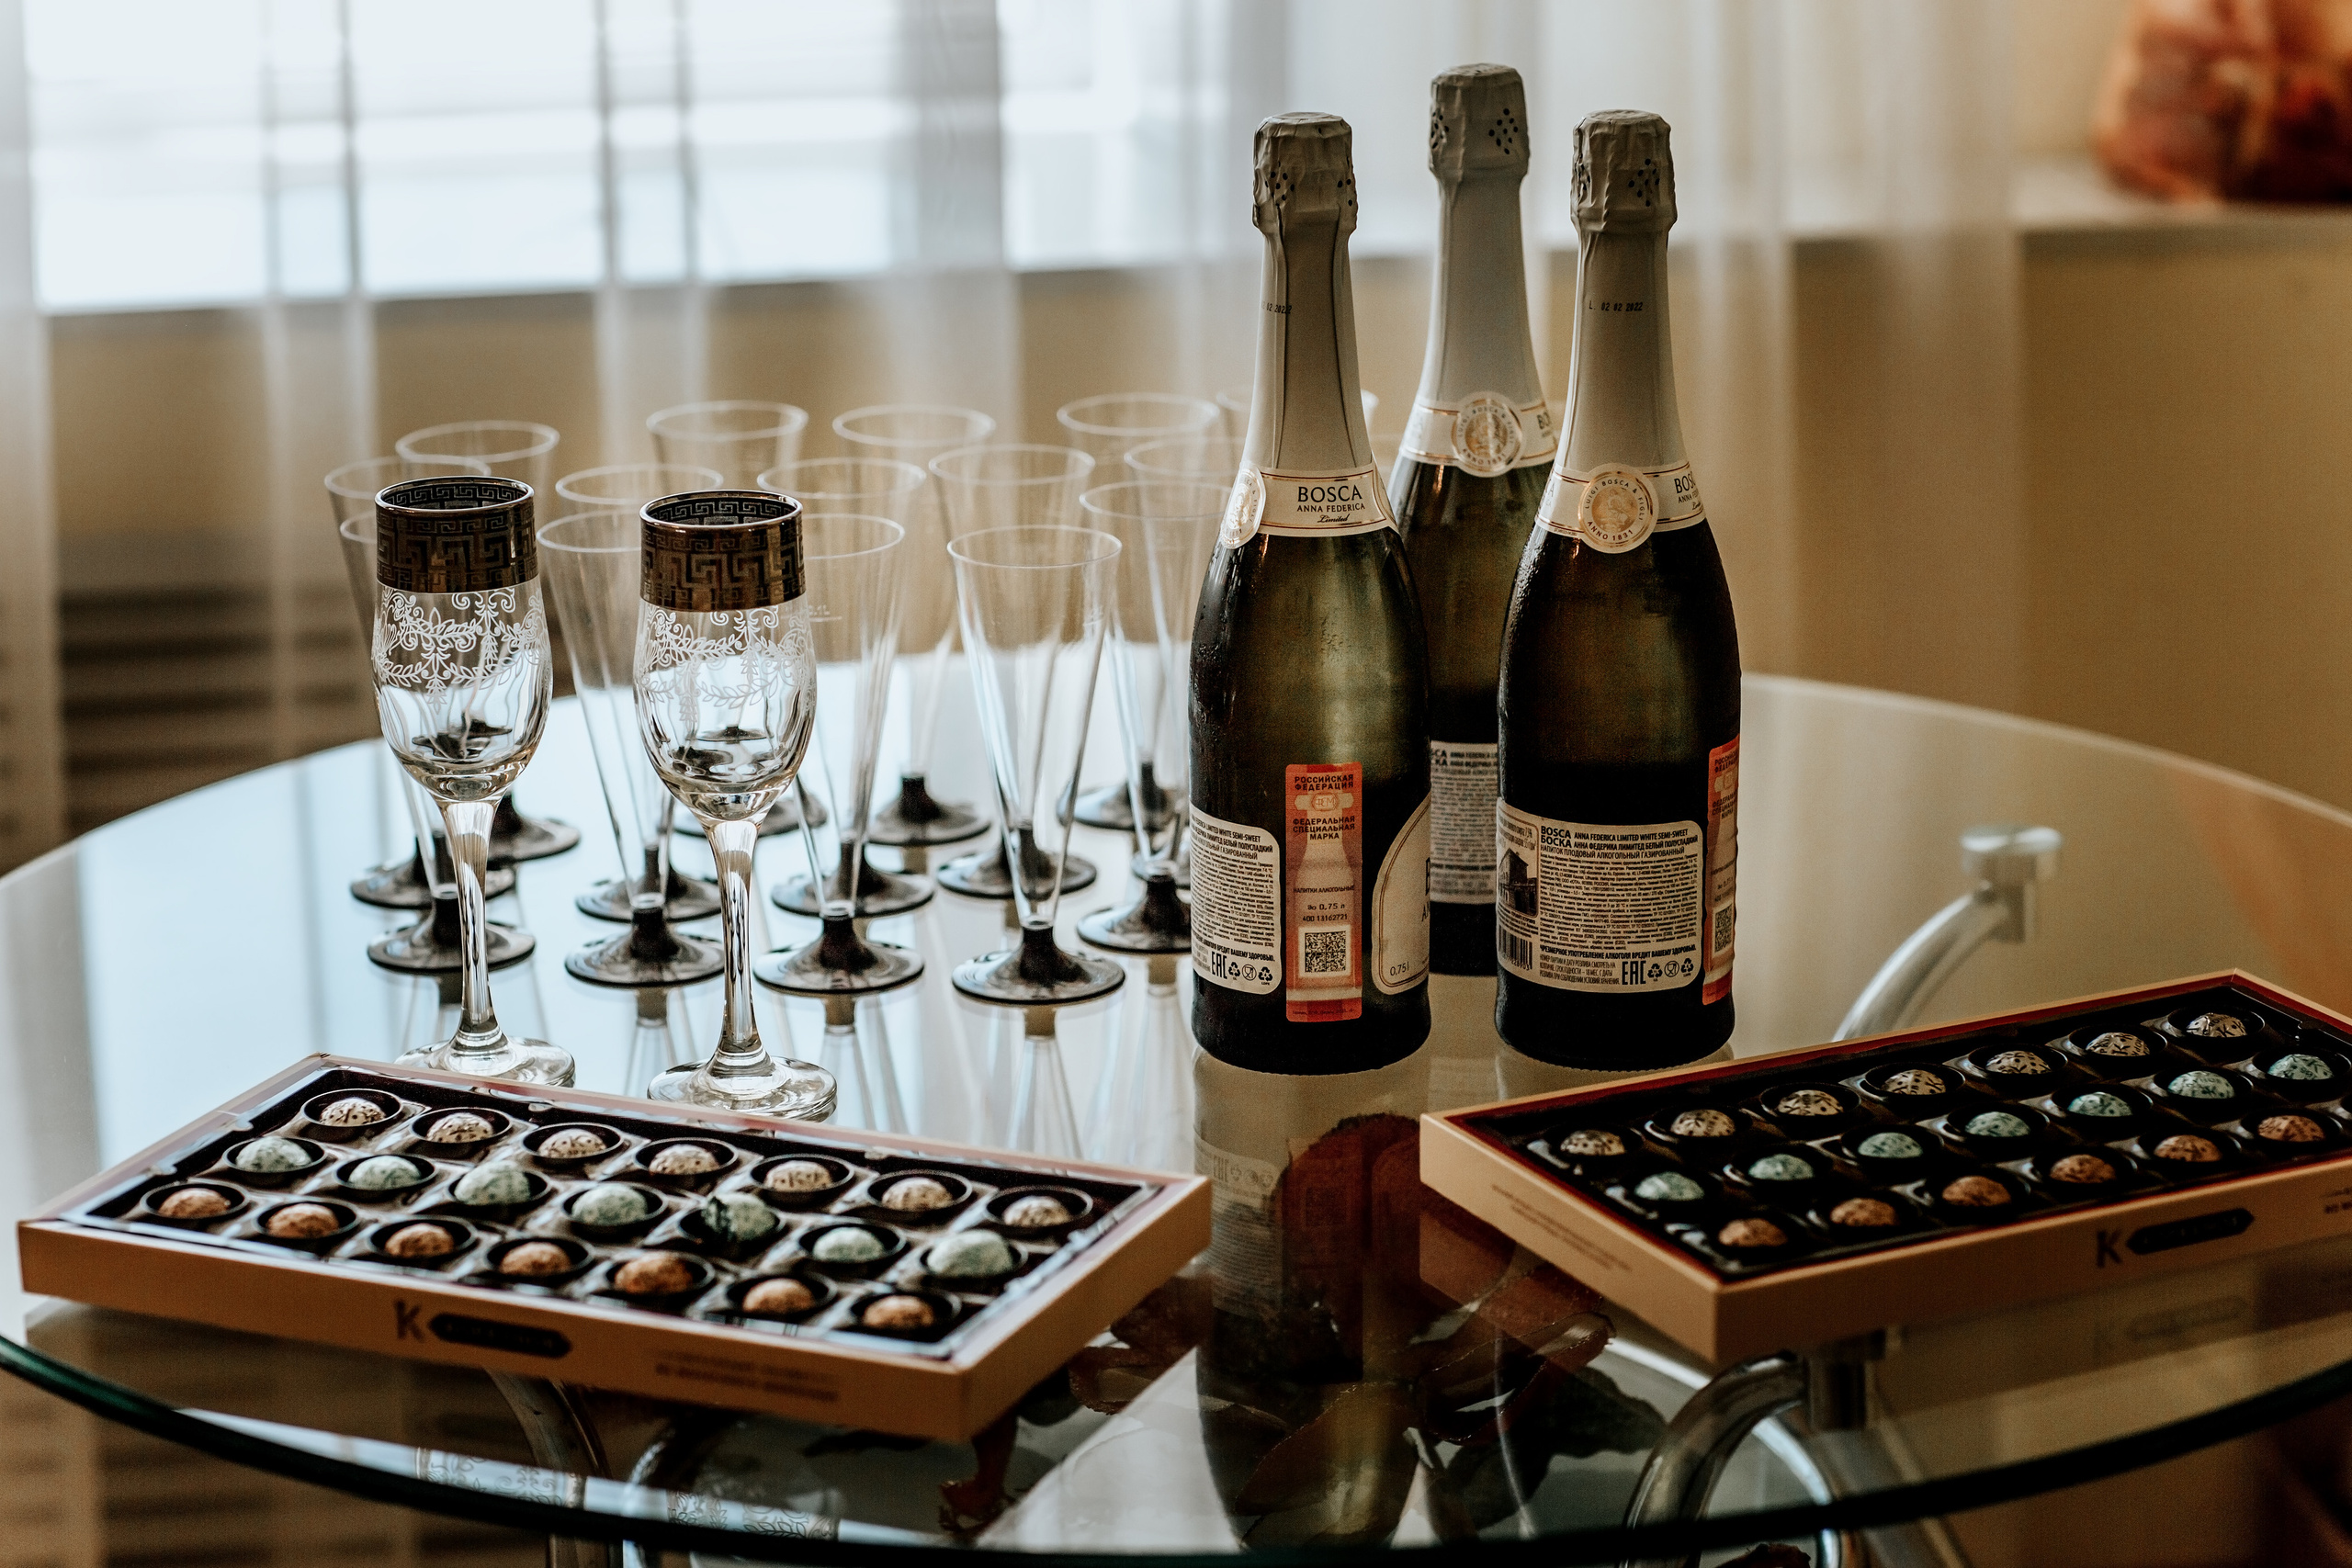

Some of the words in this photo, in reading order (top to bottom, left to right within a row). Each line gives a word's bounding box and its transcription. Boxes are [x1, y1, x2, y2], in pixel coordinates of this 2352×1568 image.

[1601, 302, 1610, 311] 02
[1625, 301, 1644, 312] 2022
[1297, 484, 1363, 503] BOSCA
[1585, 486, 1599, 509] LUIGI
[1601, 479, 1629, 488] BOSCA
[1637, 497, 1645, 521] FIGLI
[1296, 504, 1324, 513] ANNA
[1326, 502, 1366, 513] FEDERICA
[1317, 513, 1351, 524] Limited
[1588, 521, 1609, 540] ANNO
[1612, 529, 1634, 541] 1831
[1294, 773, 1354, 784] РОССИЙСКАЯ
[1295, 781, 1354, 792] ФЕДЕРАЦИЯ
[1293, 815, 1355, 826] ФЕДЕРАЛЬНАЯ
[1293, 823, 1355, 834] СПЕЦИАЛЬНАЯ
[1541, 825, 1572, 840] BOSCA
[1574, 831, 1589, 841] ANNA
[1590, 833, 1616, 841] FEDERICA
[1617, 833, 1640, 842] LIMITED
[1640, 832, 1658, 841] WHITE
[1658, 829, 1689, 840] SEMI-SWEET
[1232, 831, 1261, 843] SEMI-SWEET
[1309, 832, 1340, 840] МАРКА
[1541, 834, 1572, 849] БОСКА
[1574, 840, 1589, 850] АННА
[1589, 842, 1618, 852] ФЕДЕРИКА
[1618, 843, 1645, 852] ЛИМИТЕД
[1645, 840, 1664, 850] БЕЛЫЙ
[1540, 844, 1564, 855] НАПИТОК
[1564, 849, 1596, 859] ПЛОДОВЫЙ
[1596, 851, 1641, 860] АЛКОГОЛЬНЫЙ
[1641, 847, 1685, 859] ГАЗИРОВАННЫЙ
[1632, 951, 1652, 960] ВРЕДИТ
